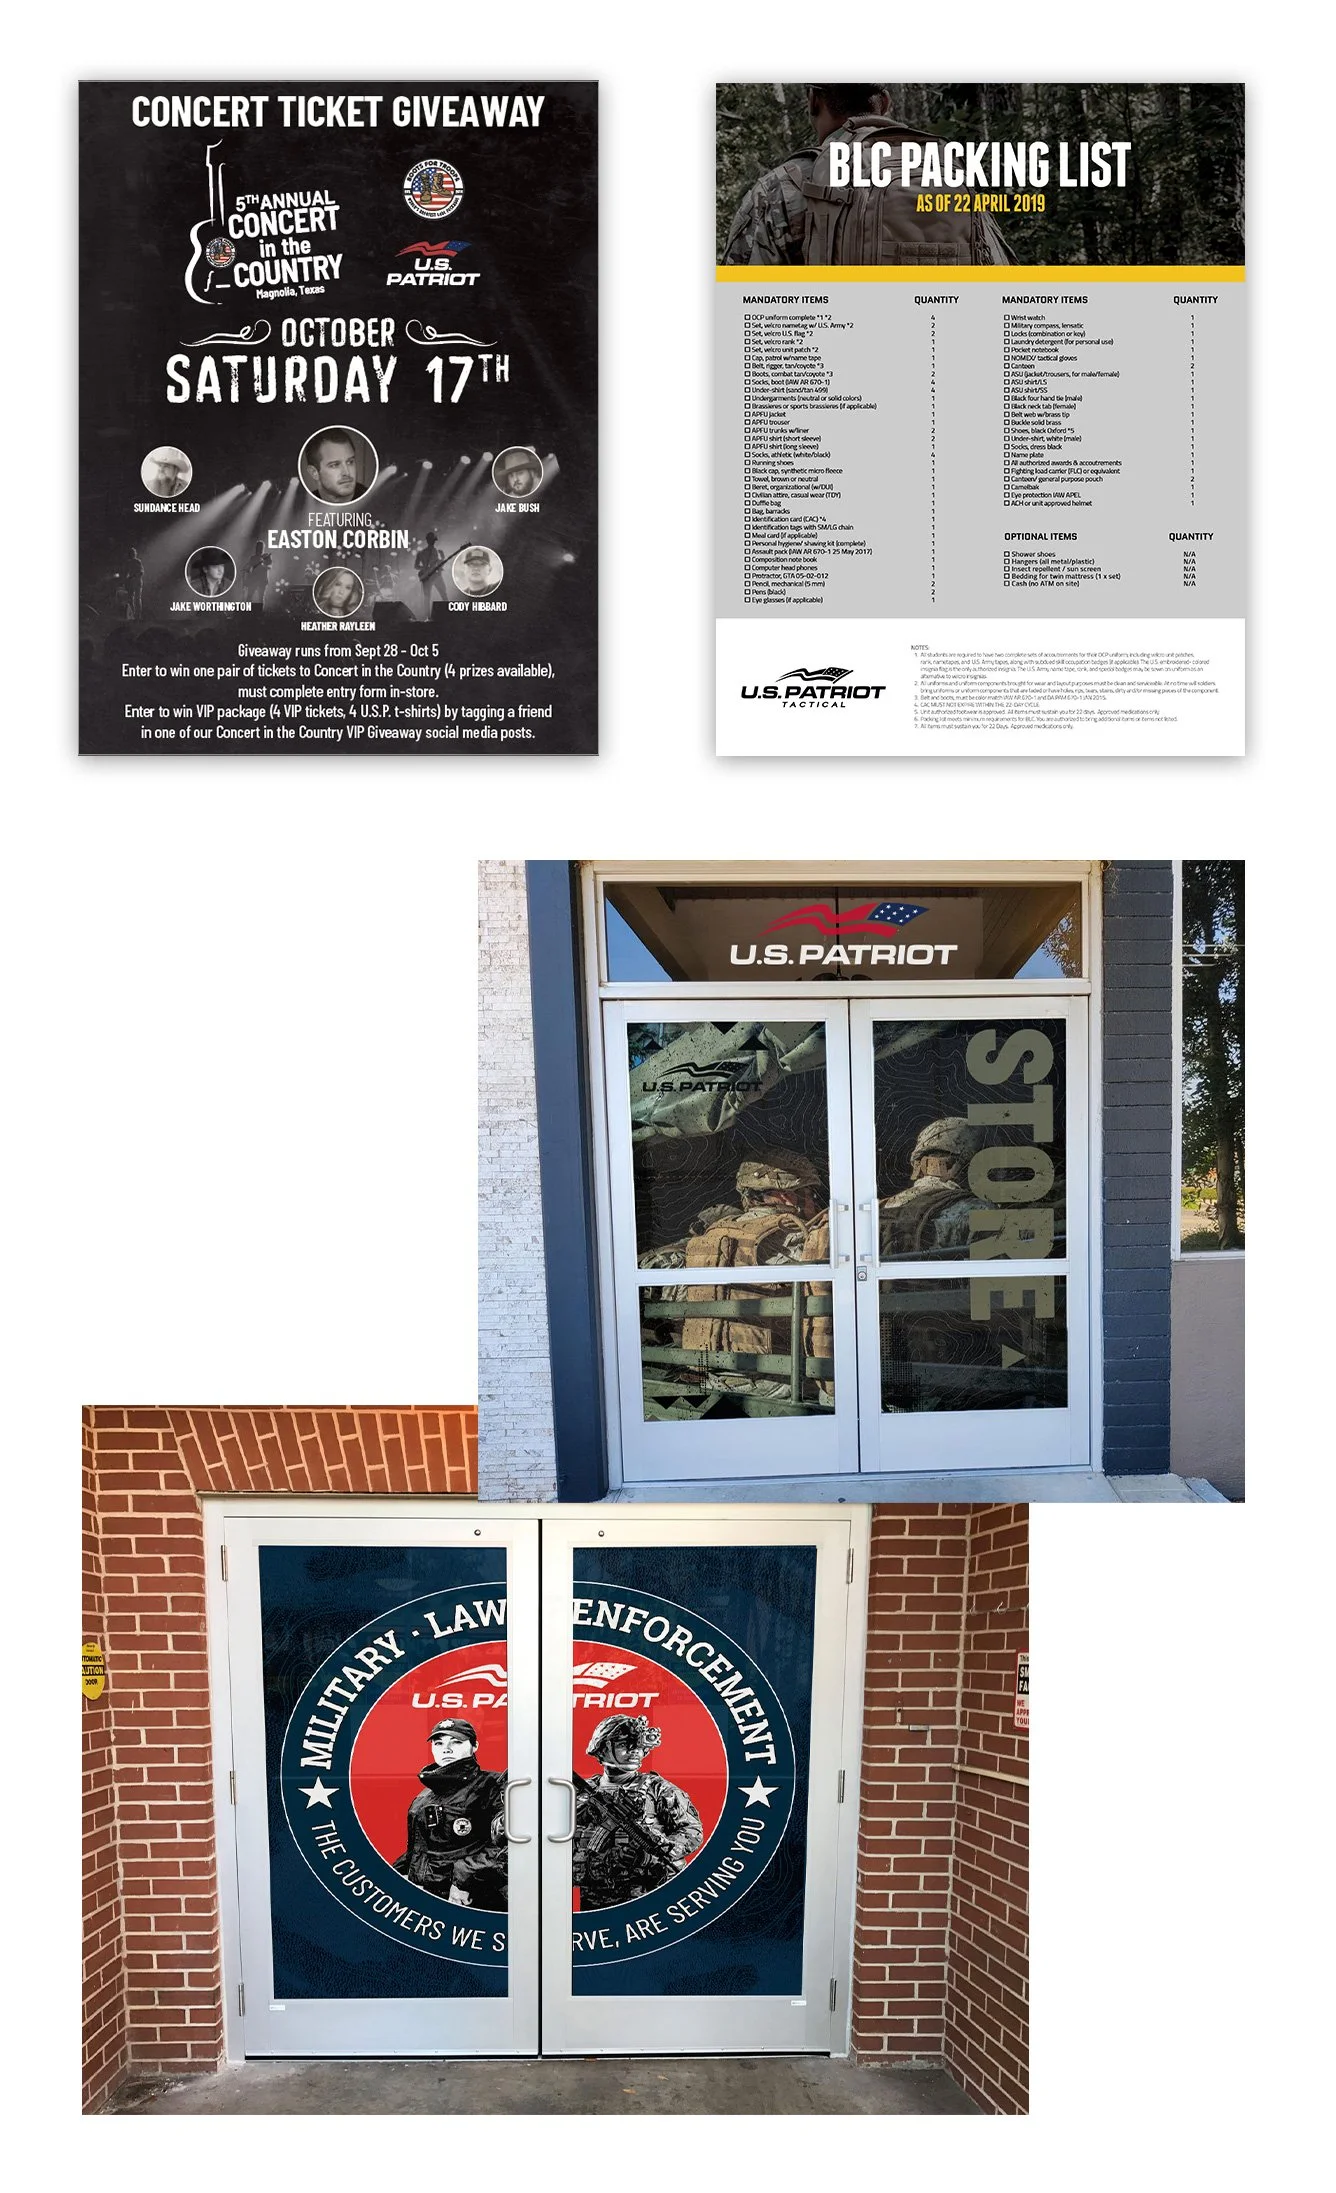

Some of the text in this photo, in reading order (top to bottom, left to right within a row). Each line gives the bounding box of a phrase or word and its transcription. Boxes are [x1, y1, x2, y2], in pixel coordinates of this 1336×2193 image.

[132, 96, 545, 127] CONCERT TICKET GIVEAWAY
[830, 142, 1131, 187] BLC PACKING LIST
[260, 189, 336, 210] ANNUAL
[916, 194, 1046, 212] AS OF 22 APRIL 2019
[228, 205, 340, 239] CONCERT
[259, 237, 312, 258] in the
[233, 253, 343, 288] COUNTRY
[414, 258, 453, 271] U.S.
[386, 273, 481, 285] PATRIOT
[256, 285, 325, 300] Magnolia, Texas
[743, 296, 829, 304] MANDATORY ITEMS
[1002, 296, 1088, 304] MANDATORY ITEMS
[1173, 296, 1218, 305] QUANTITY
[914, 296, 959, 306] QUANTITY
[282, 317, 395, 347] OCTOBER
[166, 354, 509, 403] SATURDAY 17TH
[752, 459, 776, 467] Running
[134, 503, 200, 513] SUNDANCE HEAD
[495, 503, 540, 513] JAKE BUSH
[308, 512, 373, 527] FEATURING
[268, 530, 409, 550] EASTON CORBIN
[1004, 532, 1077, 541] OPTIONAL ITEMS
[1169, 532, 1214, 542] QUANTITY
[170, 602, 251, 611] JAKE WORTHINGTON
[448, 602, 507, 611] CODY HIBBARD
[301, 622, 375, 631] HEATHER RAYLEEN
[238, 643, 292, 660] Giveaway
[295, 647, 321, 657] runs
[324, 643, 351, 657] from
[355, 643, 381, 660] Sept
[384, 643, 398, 657] 28
[410, 643, 429, 657] Oct
[432, 643, 439, 657] 5
[122, 663, 555, 680] Enter to win one pair of tickets to Concert in the Country (4 prizes available),
[238, 684, 439, 701] must complete entry form in-store.
[741, 686, 886, 699] U.S. PATRIOT
[125, 704, 552, 721] Enter to win VIP package (4 VIP tickets, 4 U.S.P. t-shirts) by tagging a friend
[141, 725, 535, 742] in one of our Concert in the Country VIP Giveaway social media posts.
[731, 945, 958, 965] U.S. PATRIOT
[642, 1081, 764, 1092] U.S. PATRIOT
[966, 1028, 1055, 1321] STORE
[82, 1666, 104, 1675] AUTION
[300, 1598, 777, 1770] MILITARY LAW ENFORCEMENT
[411, 1692, 467, 1709] U.S.
[1016, 1717, 1029, 1725] YOU
[311, 1819, 347, 1860] THE
[332, 1859, 446, 1940] CUSTOMERS
[451, 1925, 486, 1950] WE
[625, 1912, 669, 1944] ARE
[666, 1856, 745, 1924] SERVING
[730, 1816, 766, 1854] YOU
